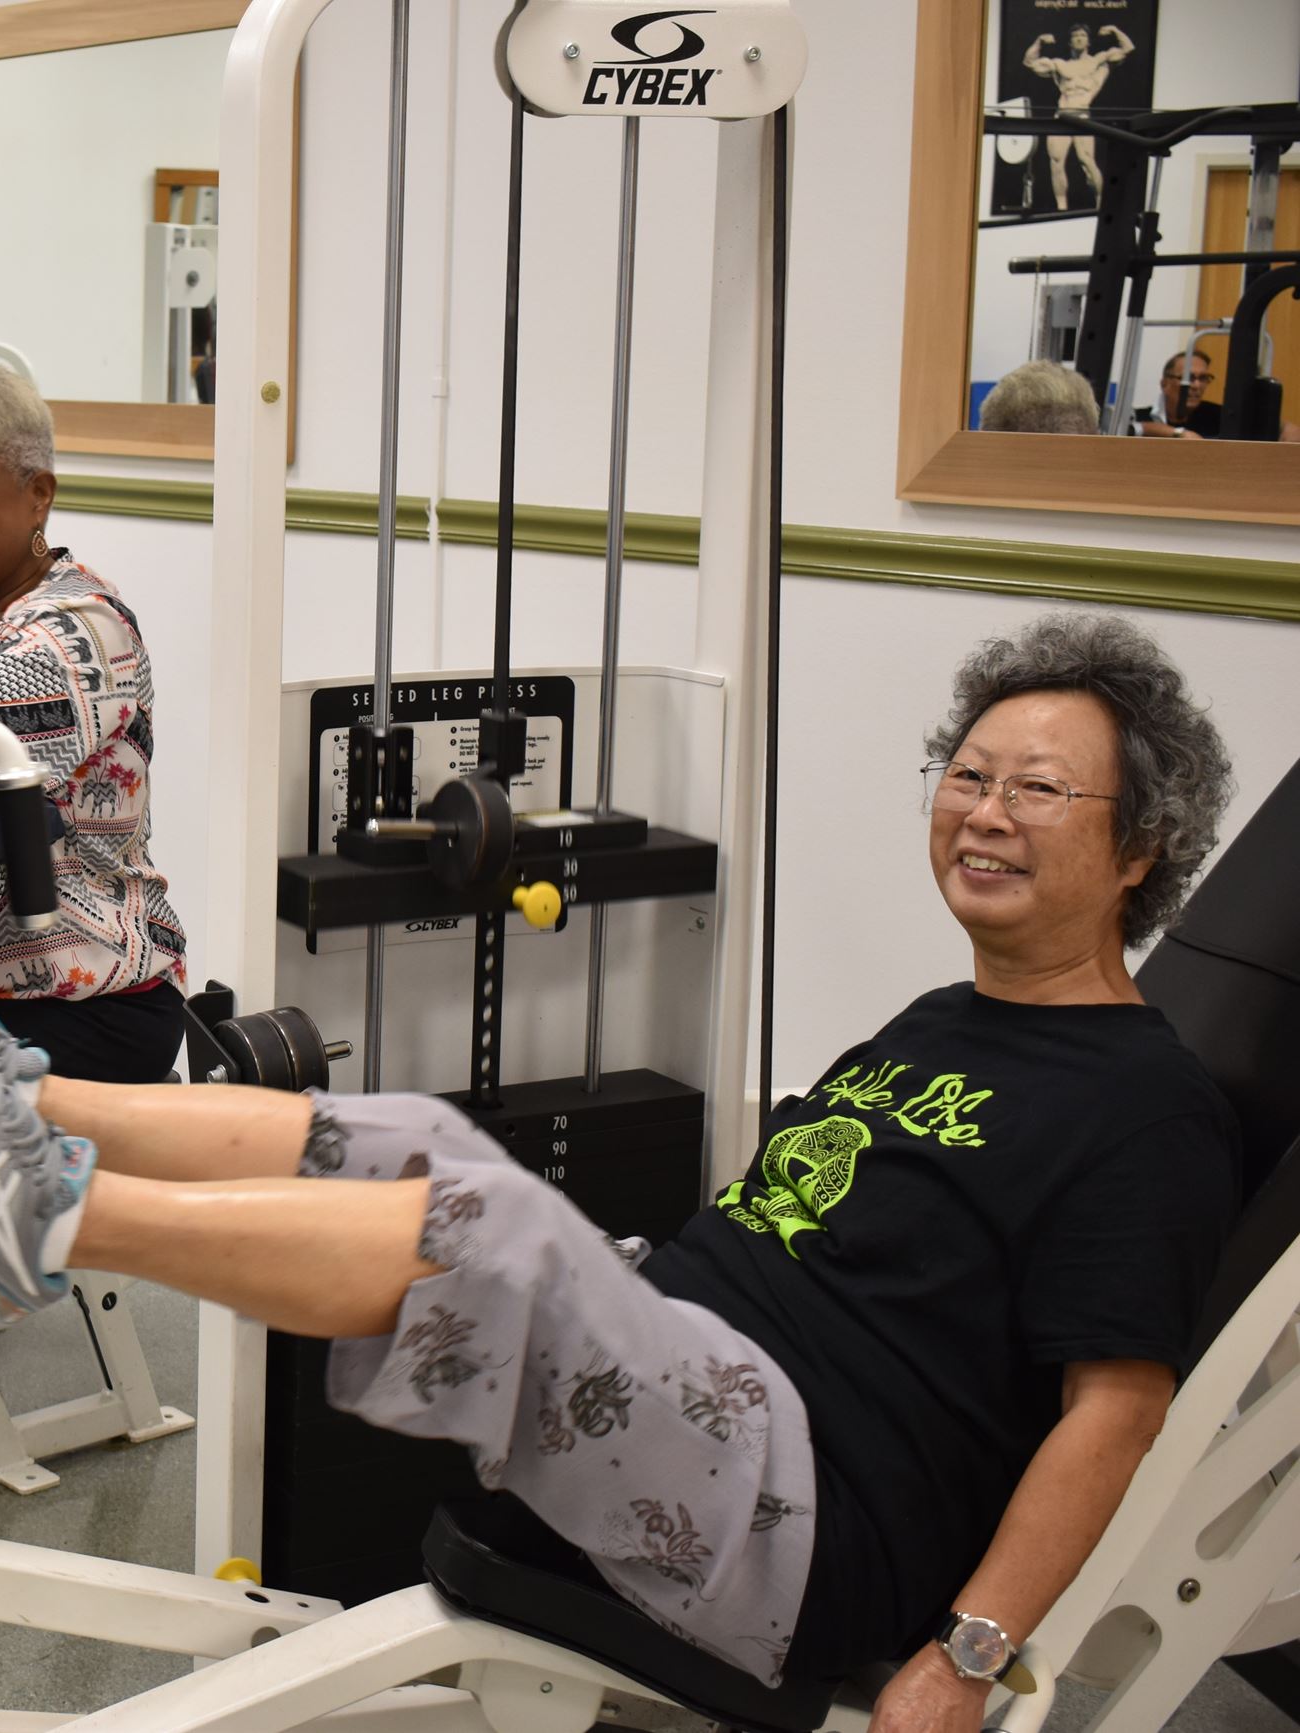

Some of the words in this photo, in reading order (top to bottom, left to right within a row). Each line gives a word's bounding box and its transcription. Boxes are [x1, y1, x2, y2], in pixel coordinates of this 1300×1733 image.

[582, 67, 717, 106] CYBEX
[352, 688, 417, 707] SEED
[431, 686, 464, 701] LEG
[478, 684, 538, 700] PSS
[559, 829, 573, 848] 10
[422, 918, 461, 931] CYBEX
[553, 1115, 567, 1130] 70
[552, 1141, 567, 1155] 90
[544, 1165, 565, 1181] 110
